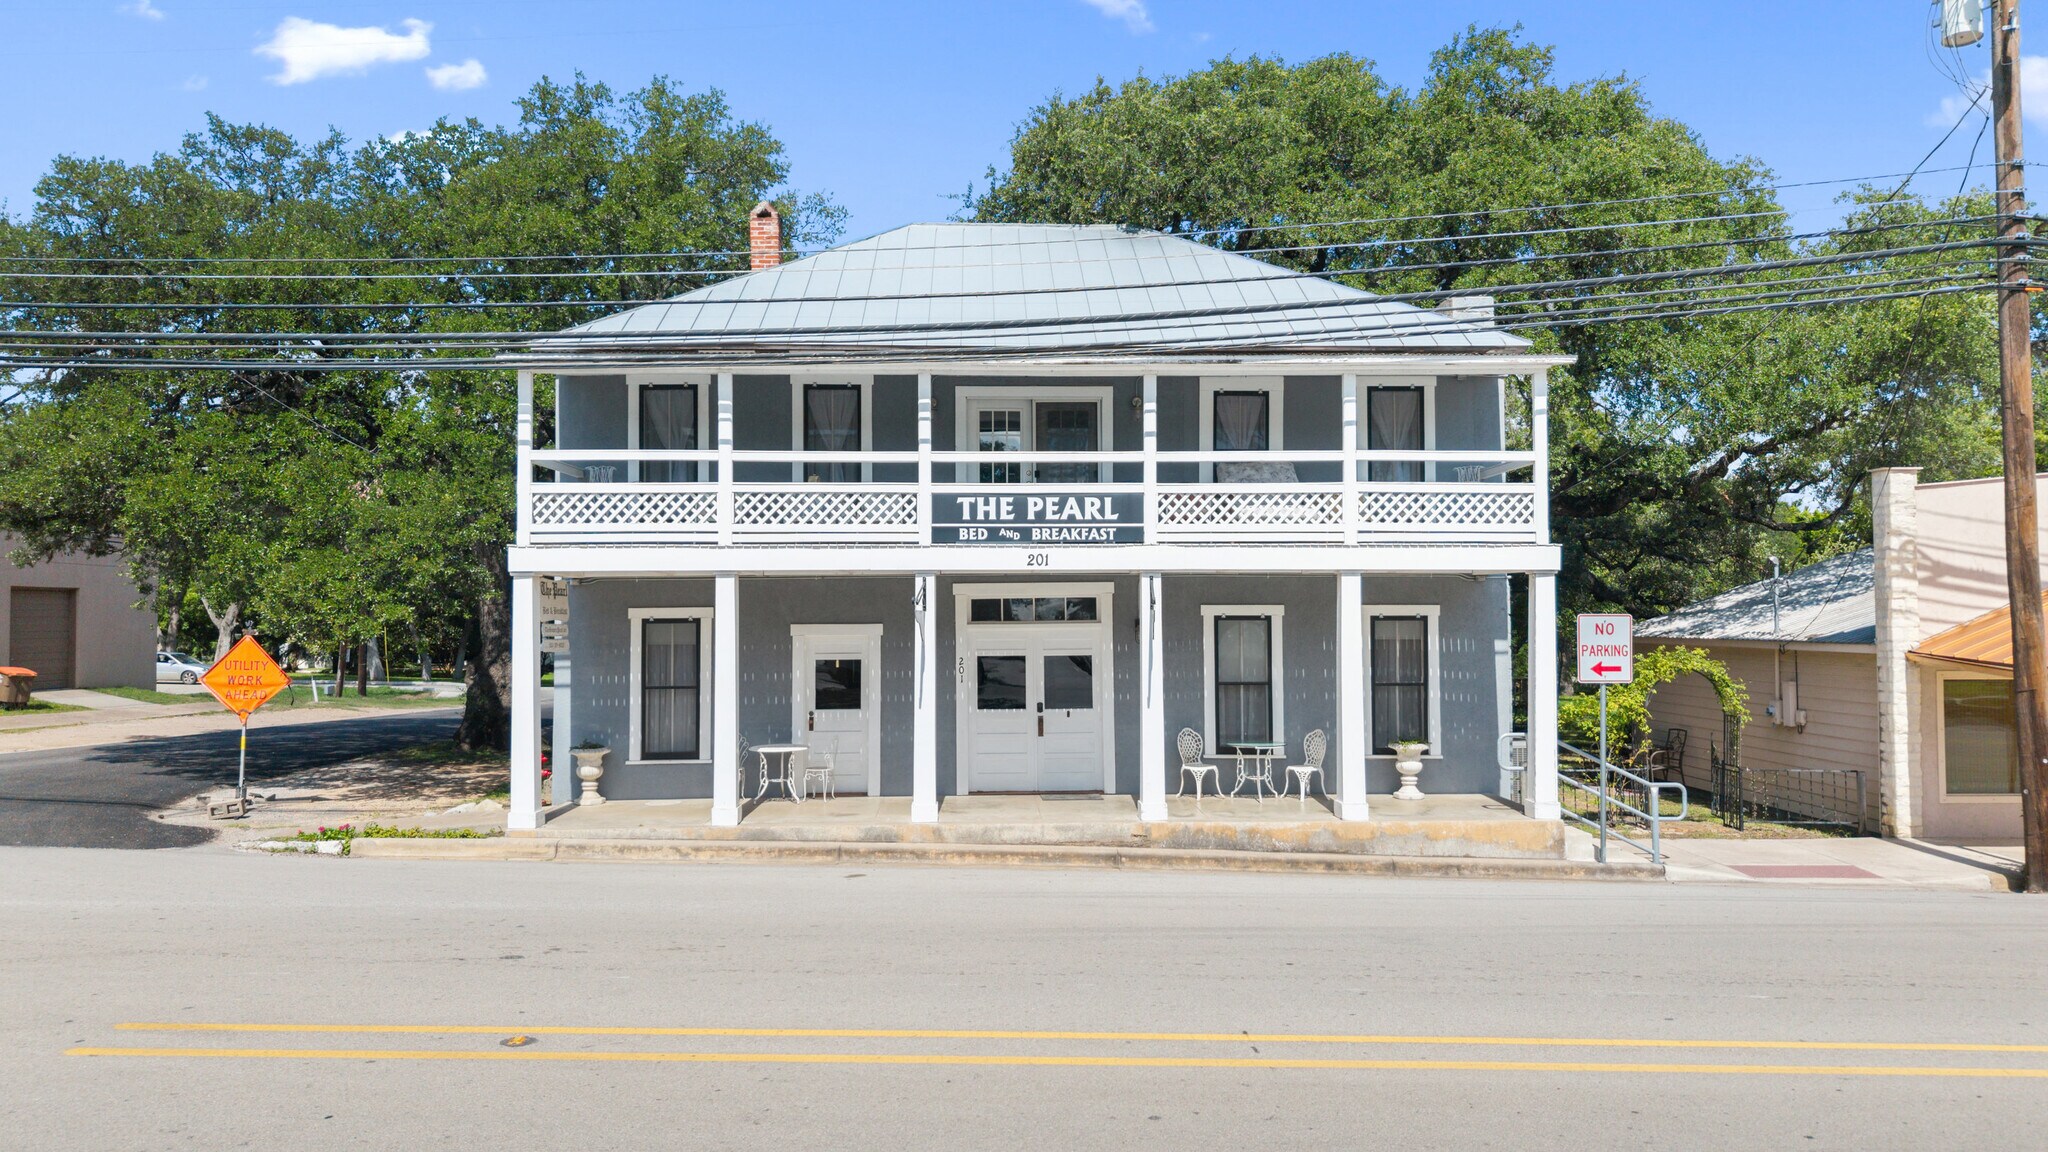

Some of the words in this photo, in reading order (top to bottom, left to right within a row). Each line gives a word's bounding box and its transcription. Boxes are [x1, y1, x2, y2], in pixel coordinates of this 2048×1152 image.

[957, 497, 1016, 521] THE
[1027, 496, 1119, 521] PEARL
[958, 528, 988, 541] BED
[999, 528, 1020, 541] AND
[1031, 528, 1117, 541] BREAKFAST
[1027, 554, 1050, 566] 201
[540, 581, 552, 599] The
[552, 581, 568, 600] Pearl
[1595, 623, 1615, 635] NO
[1581, 645, 1629, 657] PARKING
[224, 661, 269, 671] UTILITY
[227, 675, 263, 686] WORK
[225, 690, 267, 700] AHEAD
